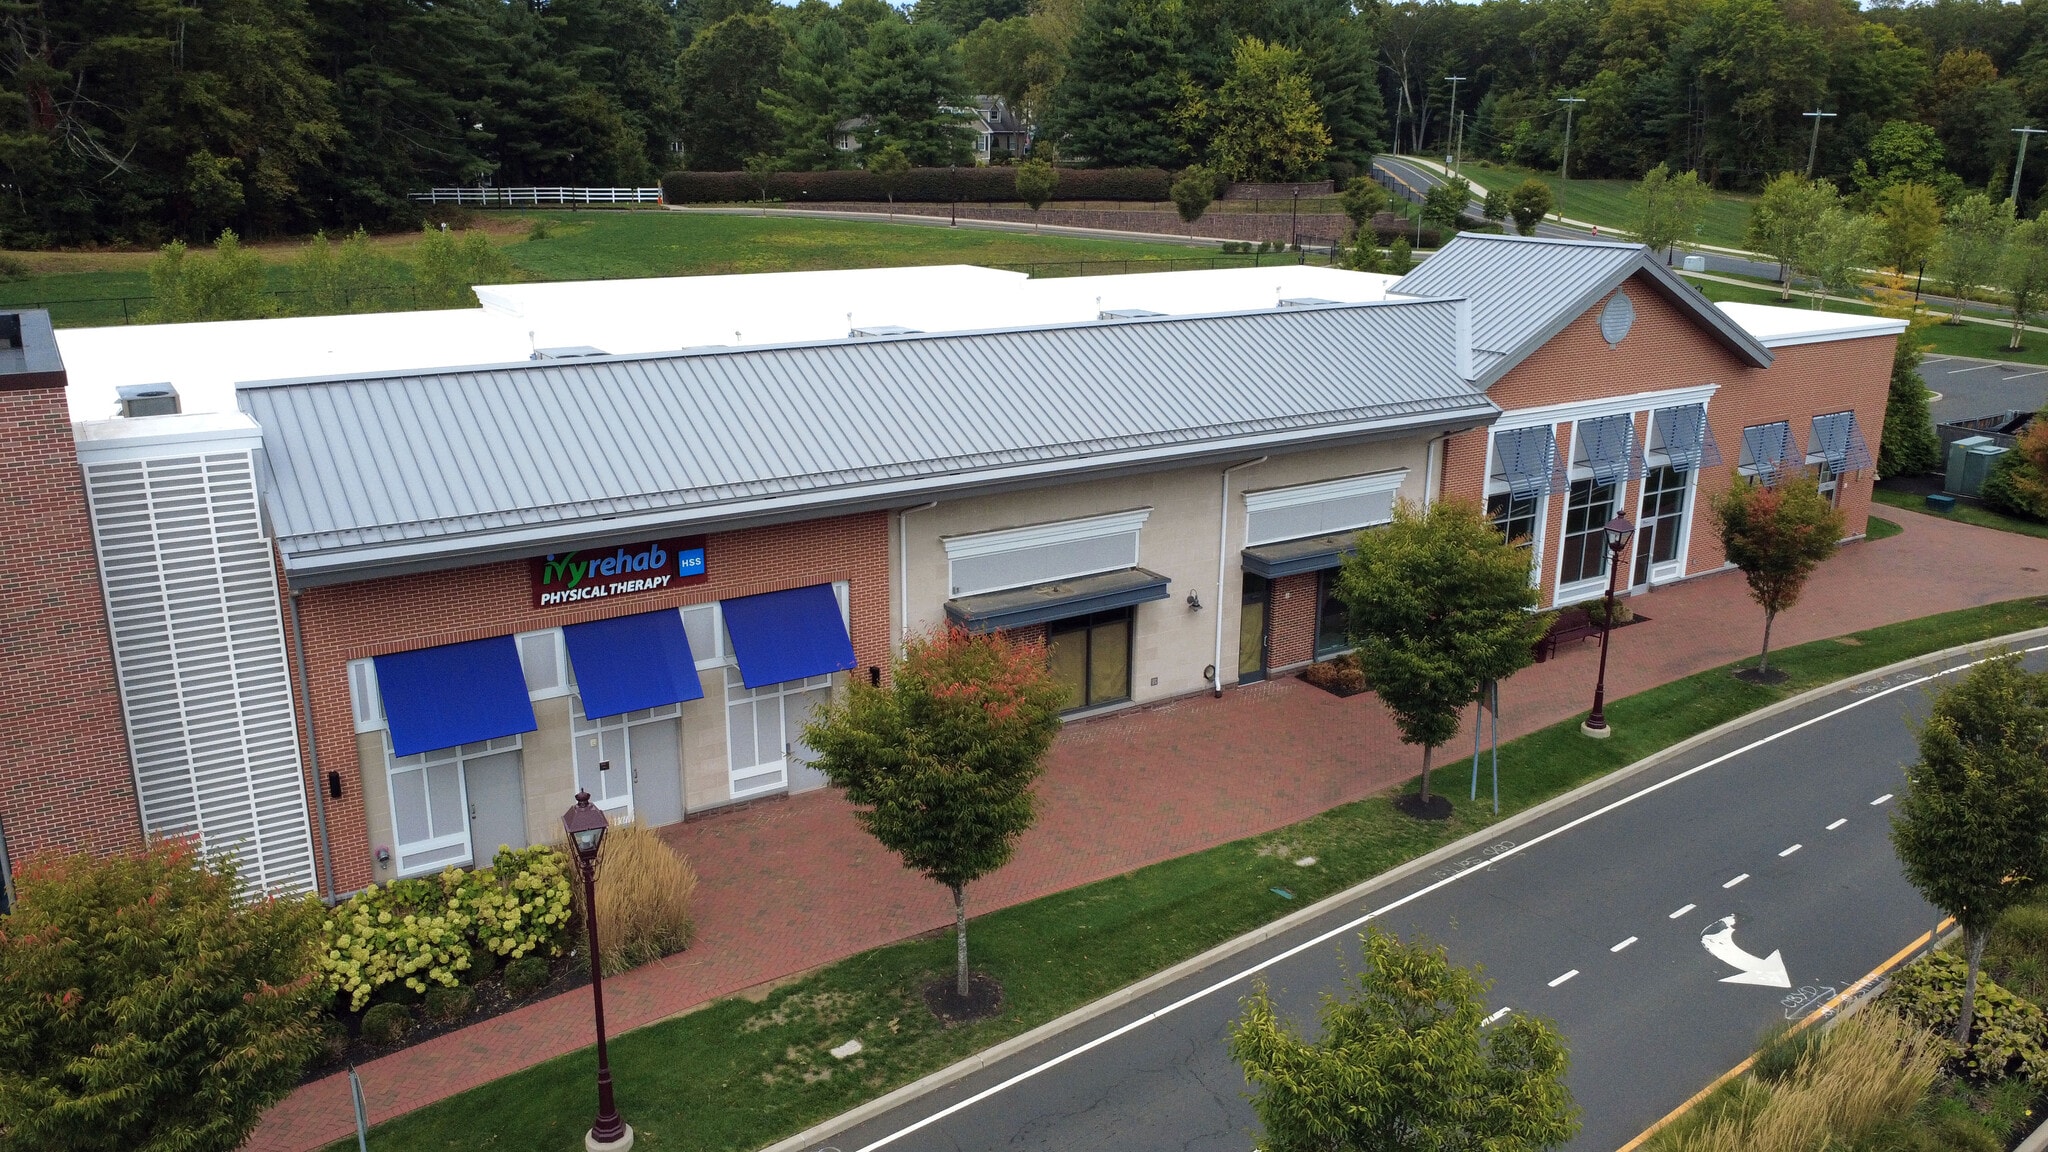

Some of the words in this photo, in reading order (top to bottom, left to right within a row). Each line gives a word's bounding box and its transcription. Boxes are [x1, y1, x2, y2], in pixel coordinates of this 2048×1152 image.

[681, 557, 702, 568] HSS
[540, 584, 608, 606] PHYSICAL
[609, 574, 671, 595] THERAPY
